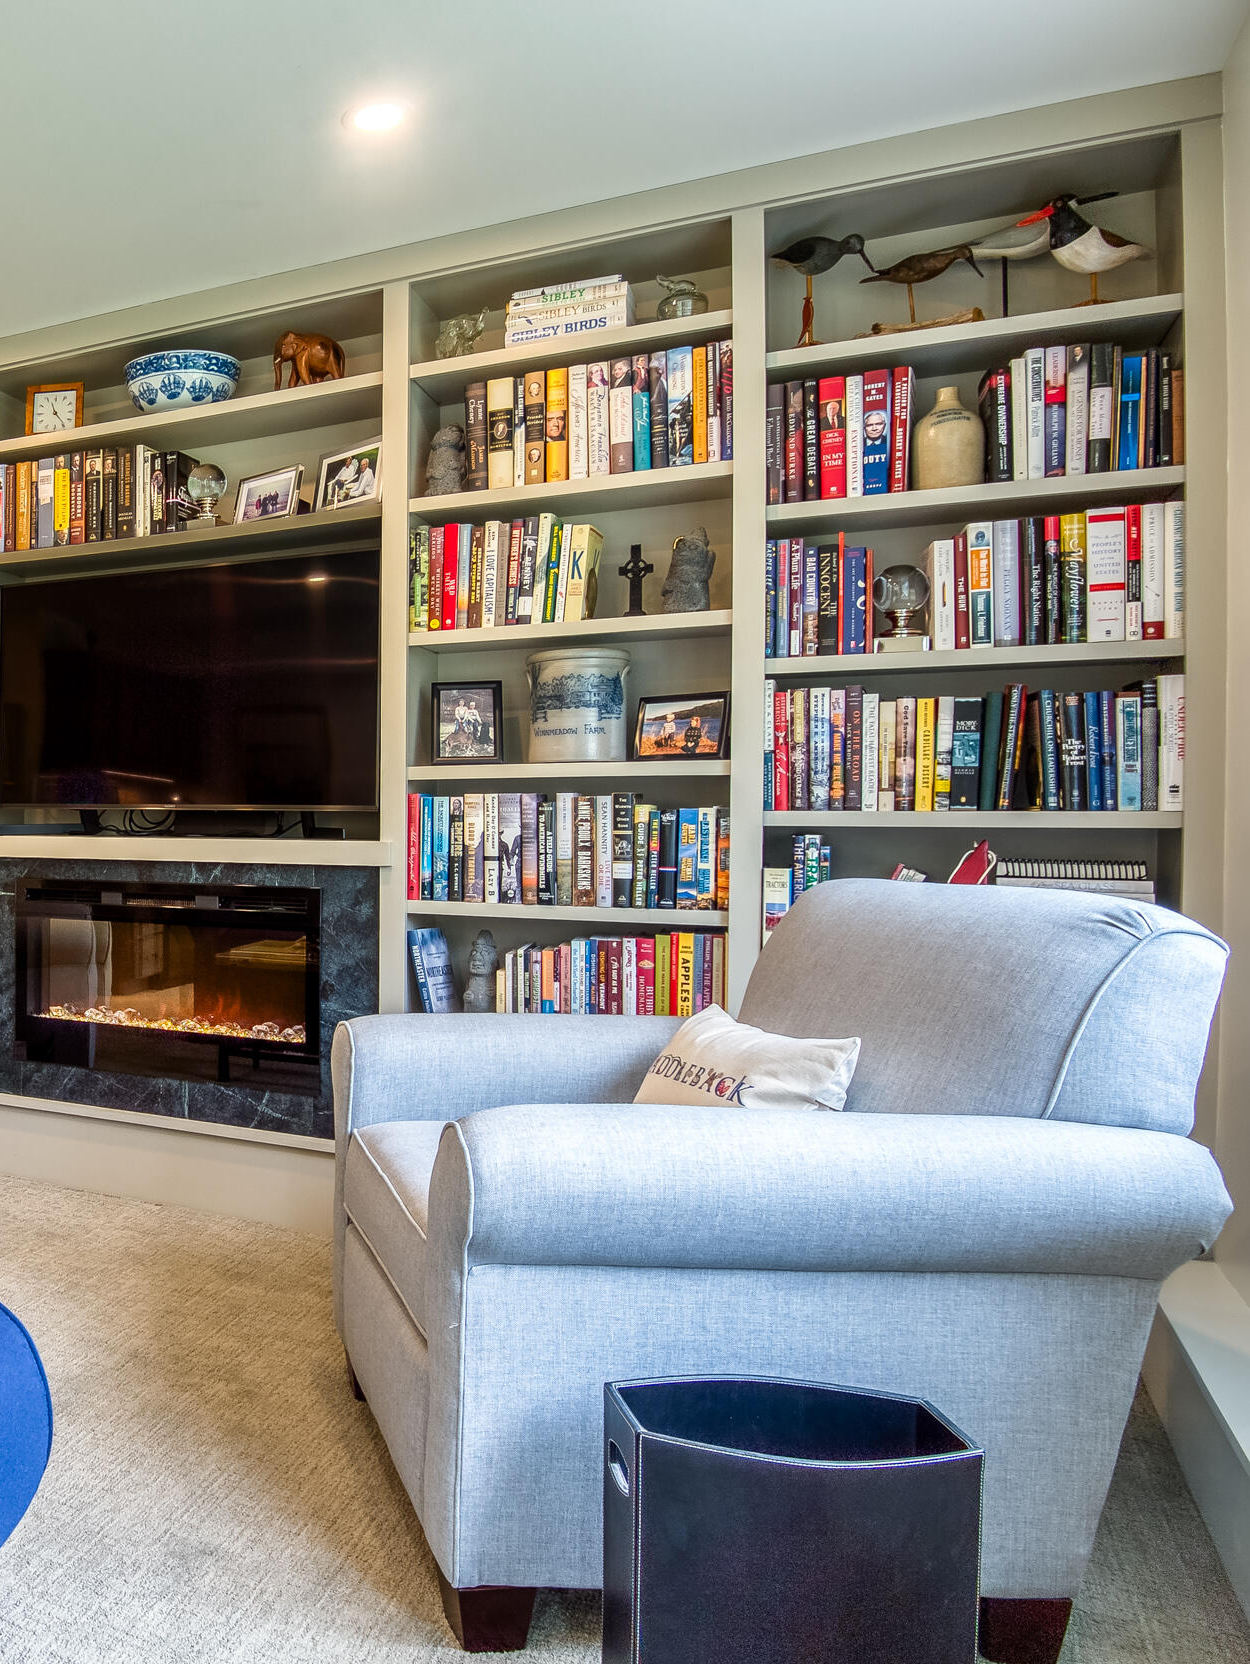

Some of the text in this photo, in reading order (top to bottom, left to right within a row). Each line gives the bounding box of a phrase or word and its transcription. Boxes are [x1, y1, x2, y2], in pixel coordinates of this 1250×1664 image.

[541, 288, 586, 303] SIBLEY
[538, 304, 607, 321] SIBLEY BIRDS
[511, 316, 607, 343] SIBLEY BIRDS
[1031, 356, 1041, 367] THE
[1052, 352, 1060, 386] LEADERSHIP
[996, 375, 1008, 446] EXTREME OWNERSHIP
[594, 389, 609, 464] Benjamin Franklin
[806, 419, 815, 444] GREAT
[788, 413, 796, 480] EDMUND BURKE
[806, 446, 816, 476] DEBATE
[822, 452, 844, 461] IN MY
[863, 453, 886, 465] DUTY
[512, 529, 520, 537] MY
[486, 554, 495, 571] LOVE
[571, 550, 583, 580] K
[791, 552, 799, 573] Plum
[1174, 539, 1183, 570] AMERICAN
[523, 556, 532, 591] PENNEY
[791, 574, 799, 590] Life
[806, 557, 816, 606] BAD COUNTRY
[820, 552, 831, 617] INNOCENT
[1066, 538, 1084, 611] Mayflower
[1174, 572, 1183, 588] MIND
[484, 573, 495, 616] CAPITALISM!
[959, 594, 967, 611] HUNT
[1031, 564, 1041, 626] The Right Nation
[1174, 591, 1183, 612] BLOOM
[584, 723, 606, 735] FARM
[853, 710, 860, 724] ON
[1006, 689, 1019, 753] ONLY THE STRONG
[833, 733, 841, 751] MAKE
[1045, 699, 1056, 793] CHURCHILL ON LEADERSHIP
[1062, 743, 1085, 751] Poetry
[1089, 725, 1100, 769] Robert Frost
[833, 753, 841, 763] ME
[833, 765, 841, 780] PULL
[539, 814, 546, 822] TO
[455, 821, 463, 857] EMPIRE
[577, 801, 591, 890] ANNIE PROULX BARKSKINS
[701, 821, 710, 863] LAST RANCH
[635, 859, 644, 906] PETER HELLER
[411, 944, 426, 983] NORTHEASTER
[599, 974, 605, 982] UP
[680, 957, 690, 1003] APPLES
[649, 1054, 755, 1108] DDLEBACK
